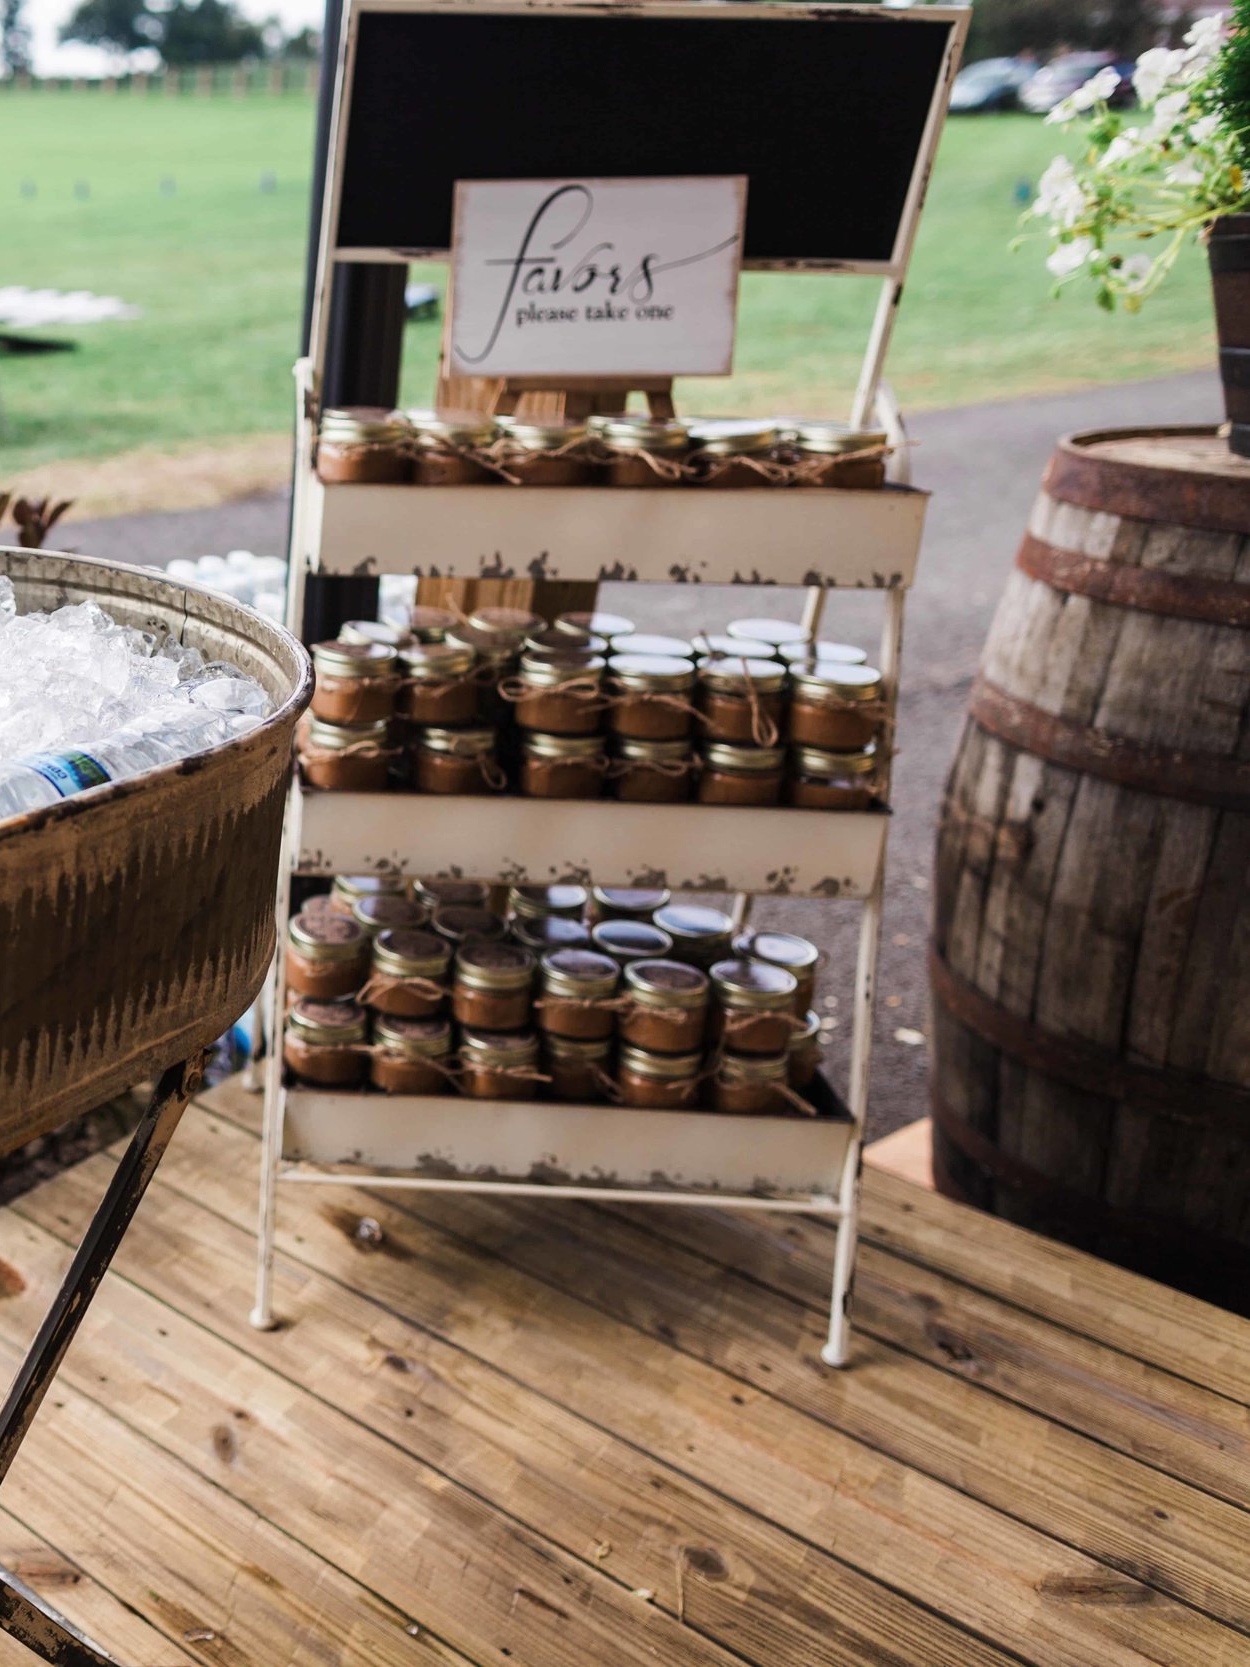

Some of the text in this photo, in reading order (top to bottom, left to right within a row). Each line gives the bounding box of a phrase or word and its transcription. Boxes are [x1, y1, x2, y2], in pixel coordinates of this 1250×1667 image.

[453, 184, 740, 364] favors
[516, 300, 674, 328] please take one
